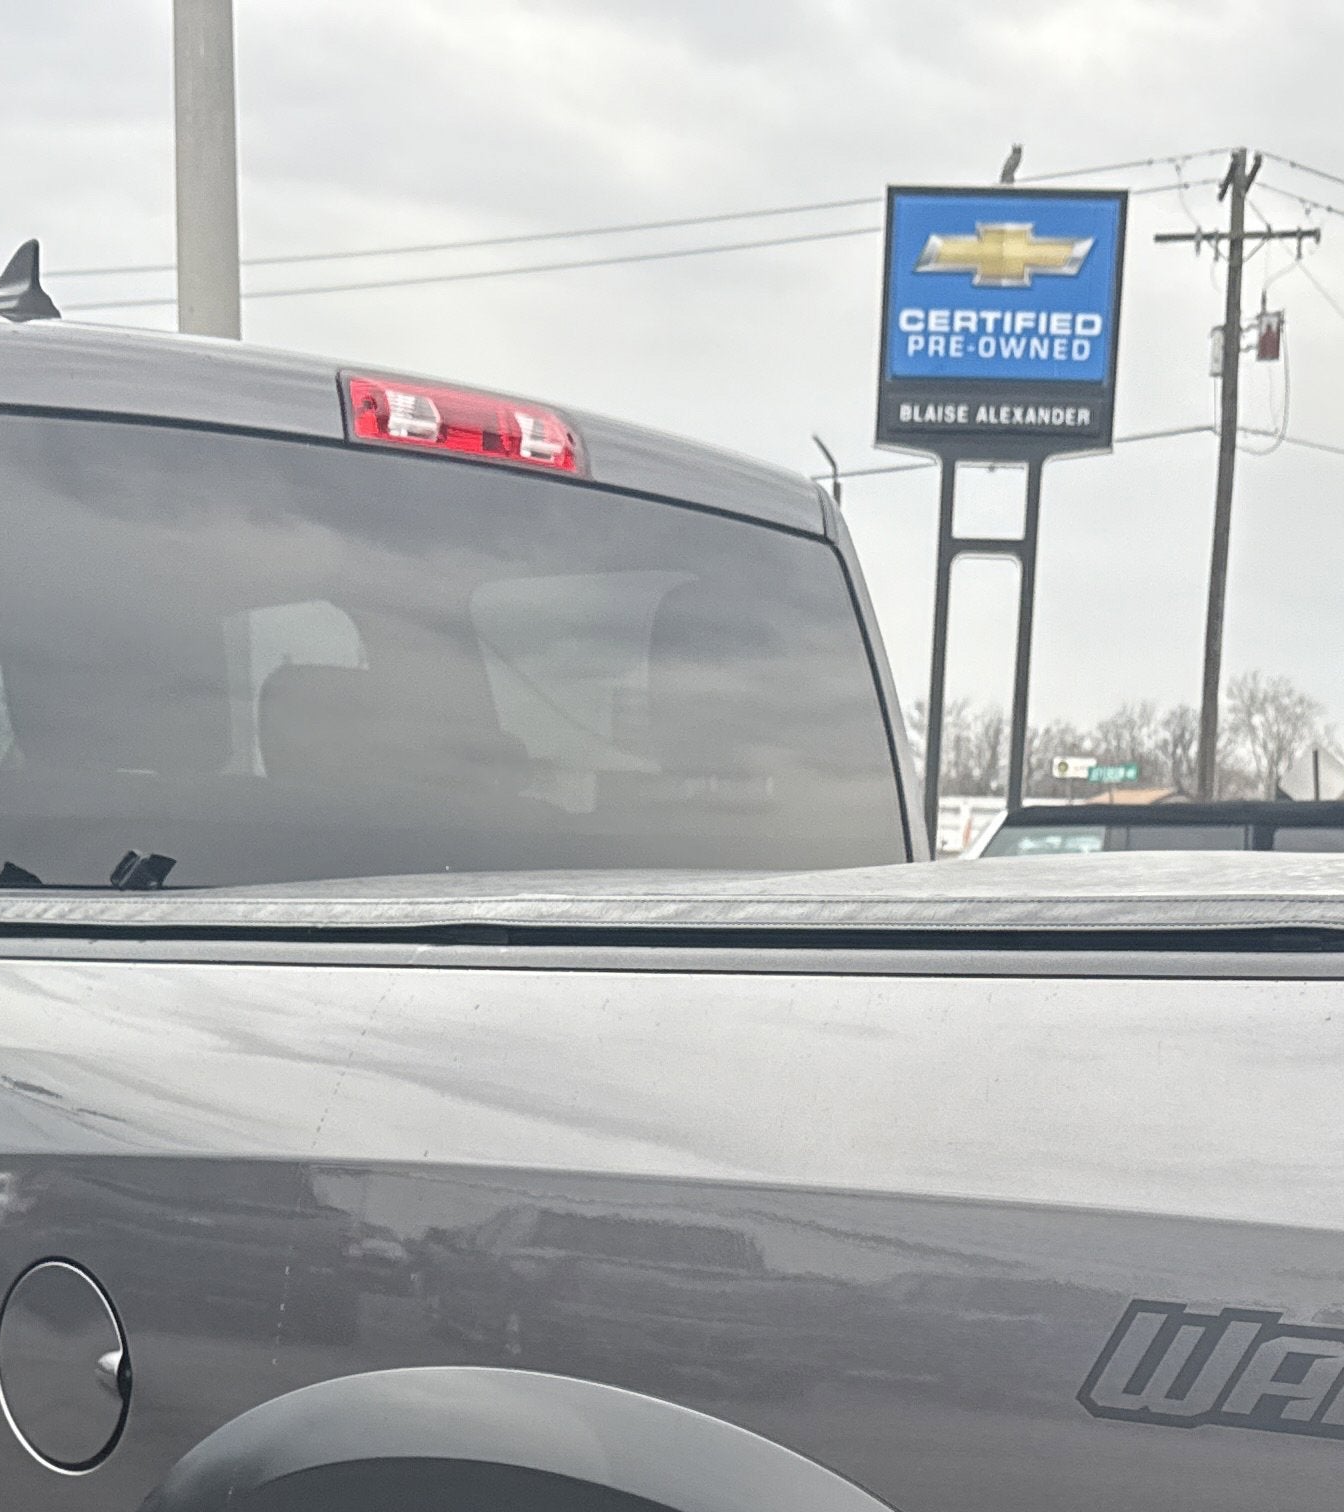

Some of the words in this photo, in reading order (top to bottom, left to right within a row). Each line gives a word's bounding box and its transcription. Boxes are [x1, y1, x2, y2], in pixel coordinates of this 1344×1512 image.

[899, 308, 1103, 337] CERTIFIED
[907, 334, 1091, 362] PRE-OWNED
[899, 404, 969, 425] BLAISE
[975, 405, 1091, 427] ALEXANDER
